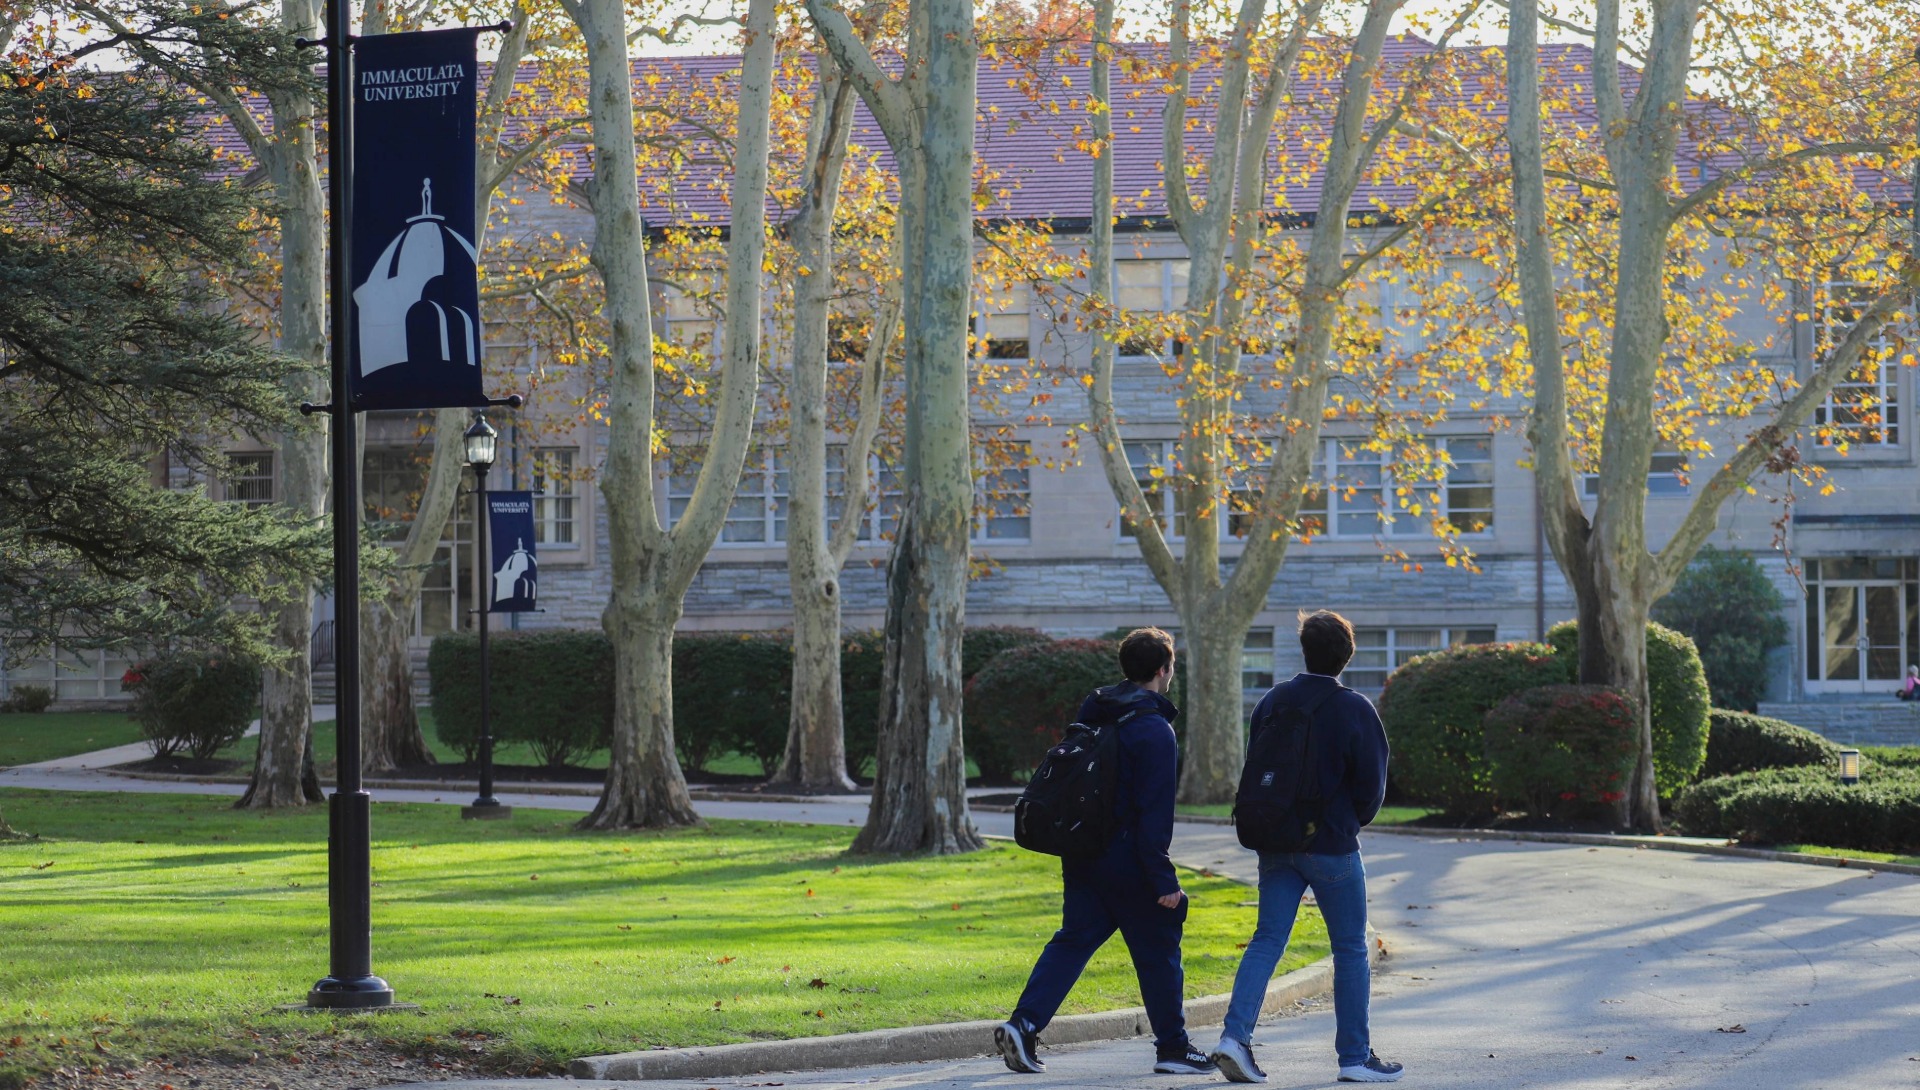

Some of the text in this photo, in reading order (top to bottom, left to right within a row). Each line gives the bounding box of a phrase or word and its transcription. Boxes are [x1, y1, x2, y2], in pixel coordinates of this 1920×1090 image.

[361, 64, 465, 86] IMMACULATA
[364, 81, 461, 101] UNIVERSITY
[1186, 1052, 1208, 1063] HOKA
